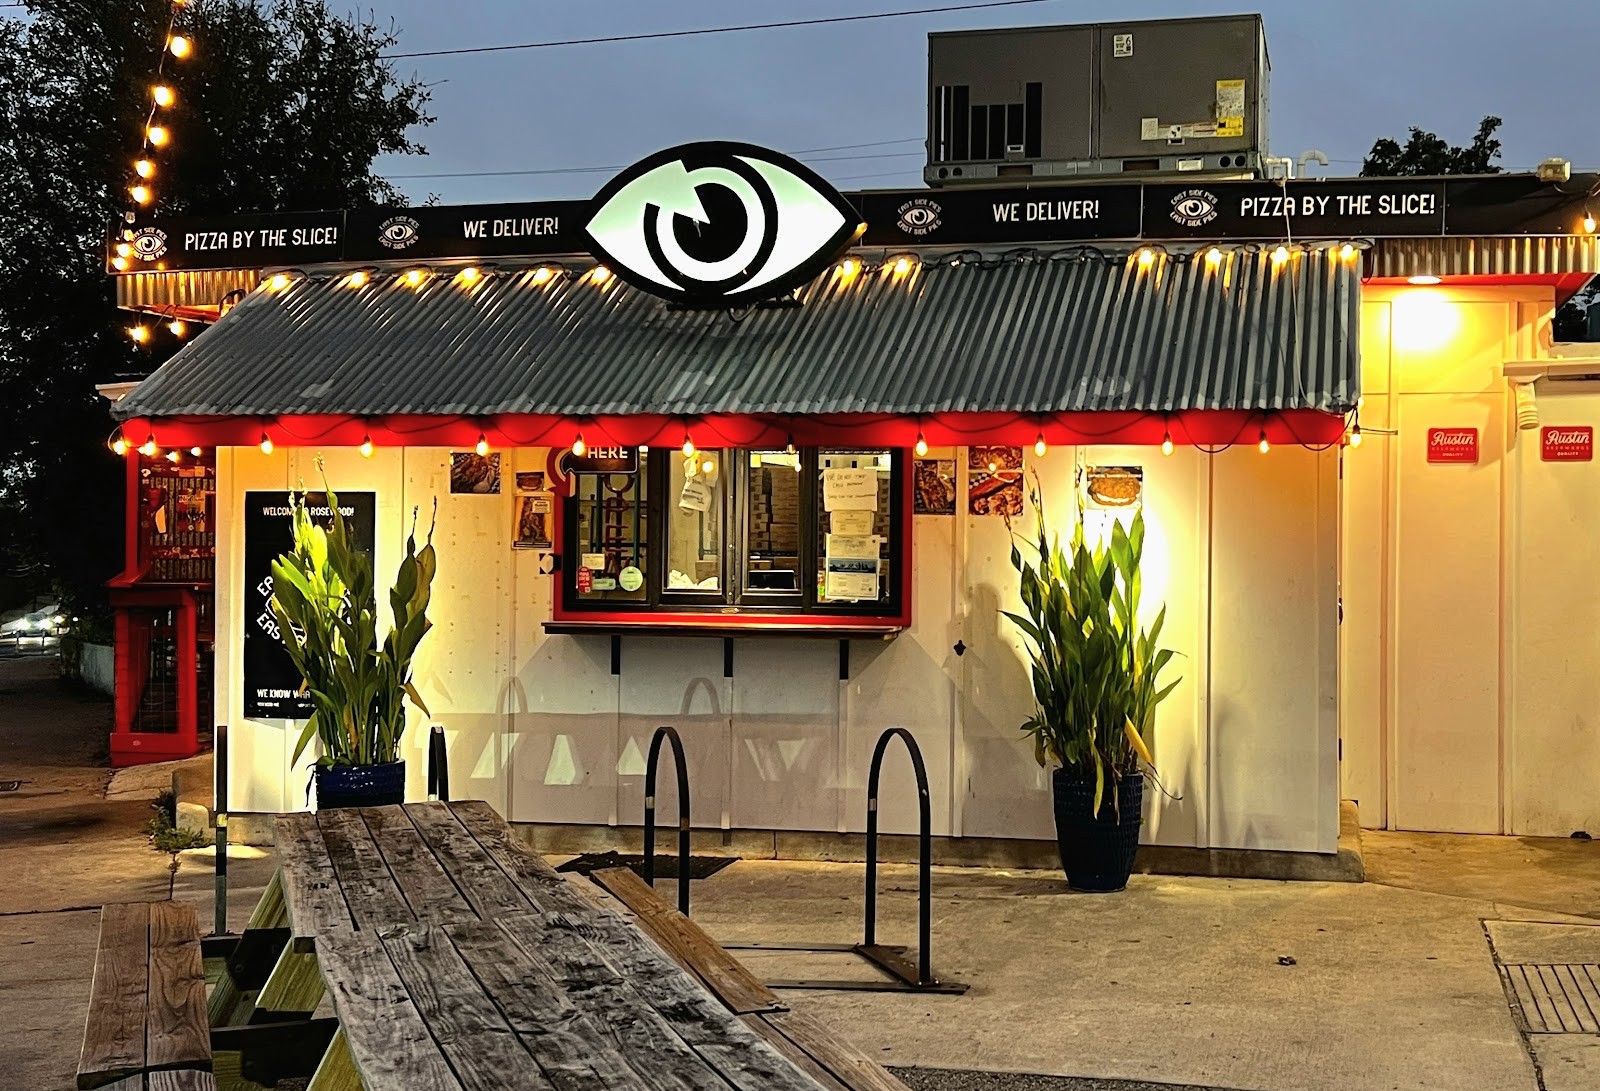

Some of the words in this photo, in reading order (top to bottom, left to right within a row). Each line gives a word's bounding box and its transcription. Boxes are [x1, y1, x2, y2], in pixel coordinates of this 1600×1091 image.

[992, 203, 1020, 222] WE
[1026, 200, 1099, 221] DELIVER!
[1240, 197, 1296, 217] PIZZA
[1302, 196, 1330, 216] BY
[1336, 195, 1372, 215] THE
[1378, 194, 1435, 215] SLICE!
[185, 232, 228, 251] PIZZA
[233, 230, 255, 249] BY
[260, 229, 288, 247] THE
[291, 227, 338, 245] SLICE!
[463, 220, 488, 239] WE
[493, 217, 559, 237] DELIVER!
[1431, 431, 1474, 446] Austin
[1545, 430, 1590, 445] Austin
[587, 446, 629, 459] HERE
[262, 506, 295, 517] WELCOM
[256, 575, 274, 597] EA
[256, 613, 285, 645] EAS
[256, 688, 268, 698] WE
[269, 688, 291, 699] KNOW
[292, 689, 311, 699] WHA
